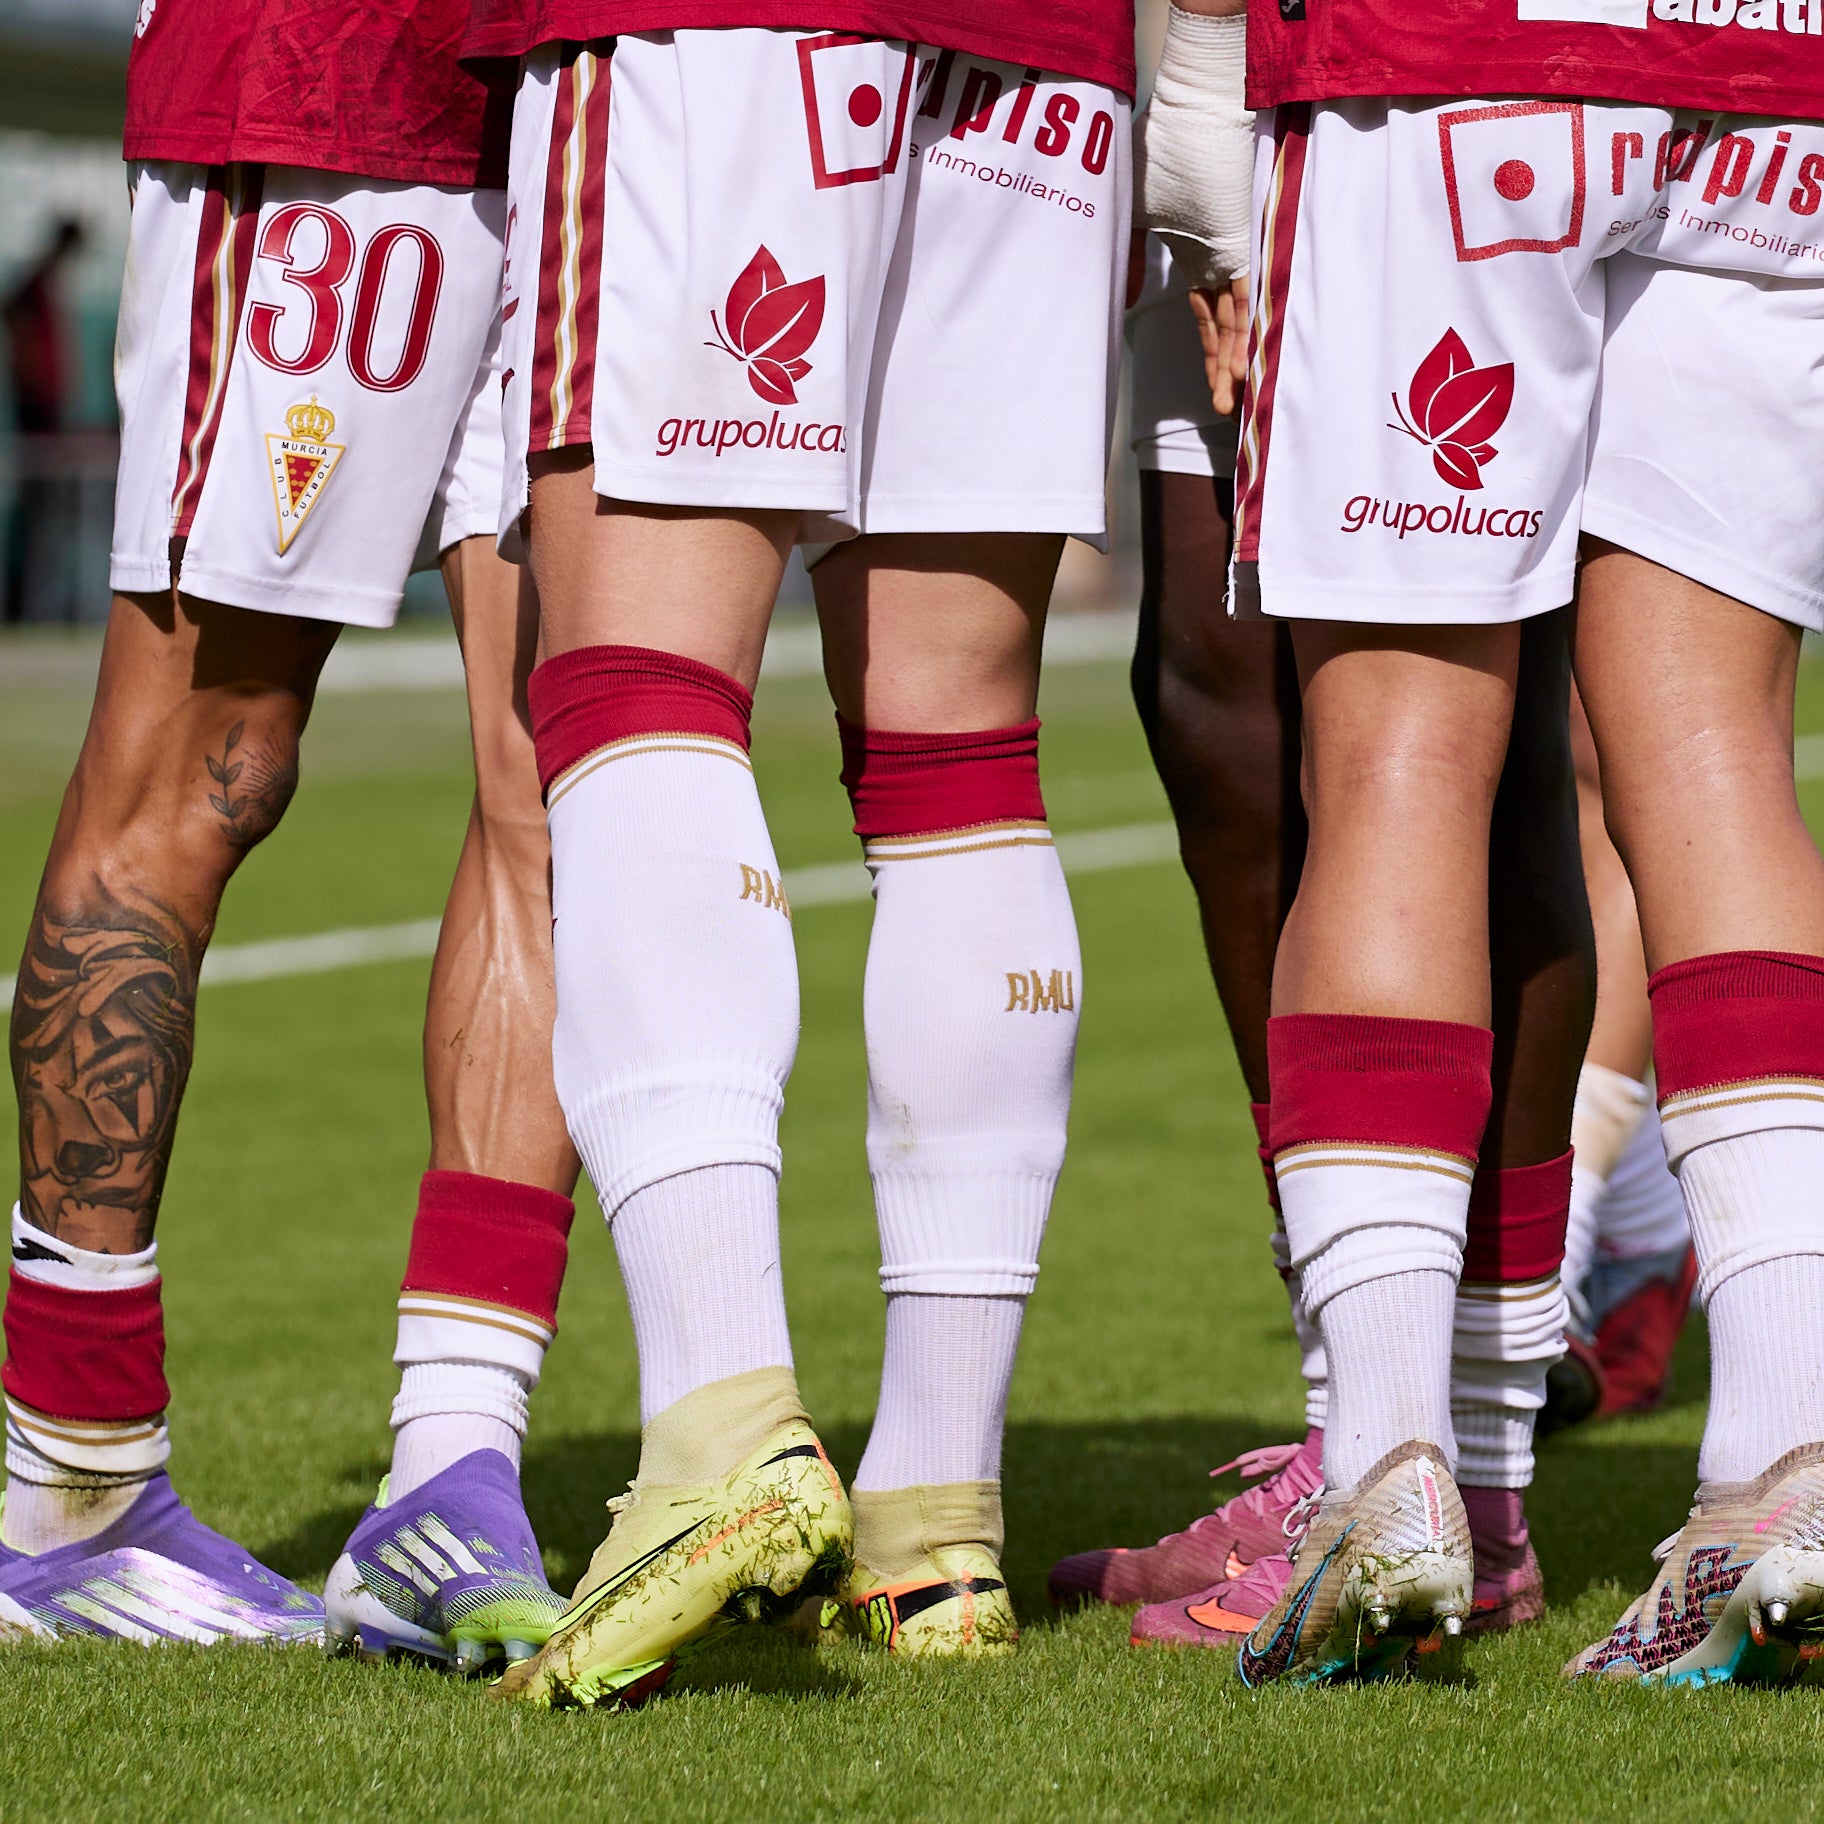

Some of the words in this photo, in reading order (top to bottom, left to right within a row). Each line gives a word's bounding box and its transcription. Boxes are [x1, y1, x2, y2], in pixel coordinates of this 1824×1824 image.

[928, 145, 1097, 219] Inmobiliarios
[246, 202, 444, 393] 30
[281, 441, 328, 456] MURCIA
[274, 457, 290, 518] CLUB
[293, 462, 331, 519] FUTBOL
[1340, 494, 1544, 540] grupolucas
